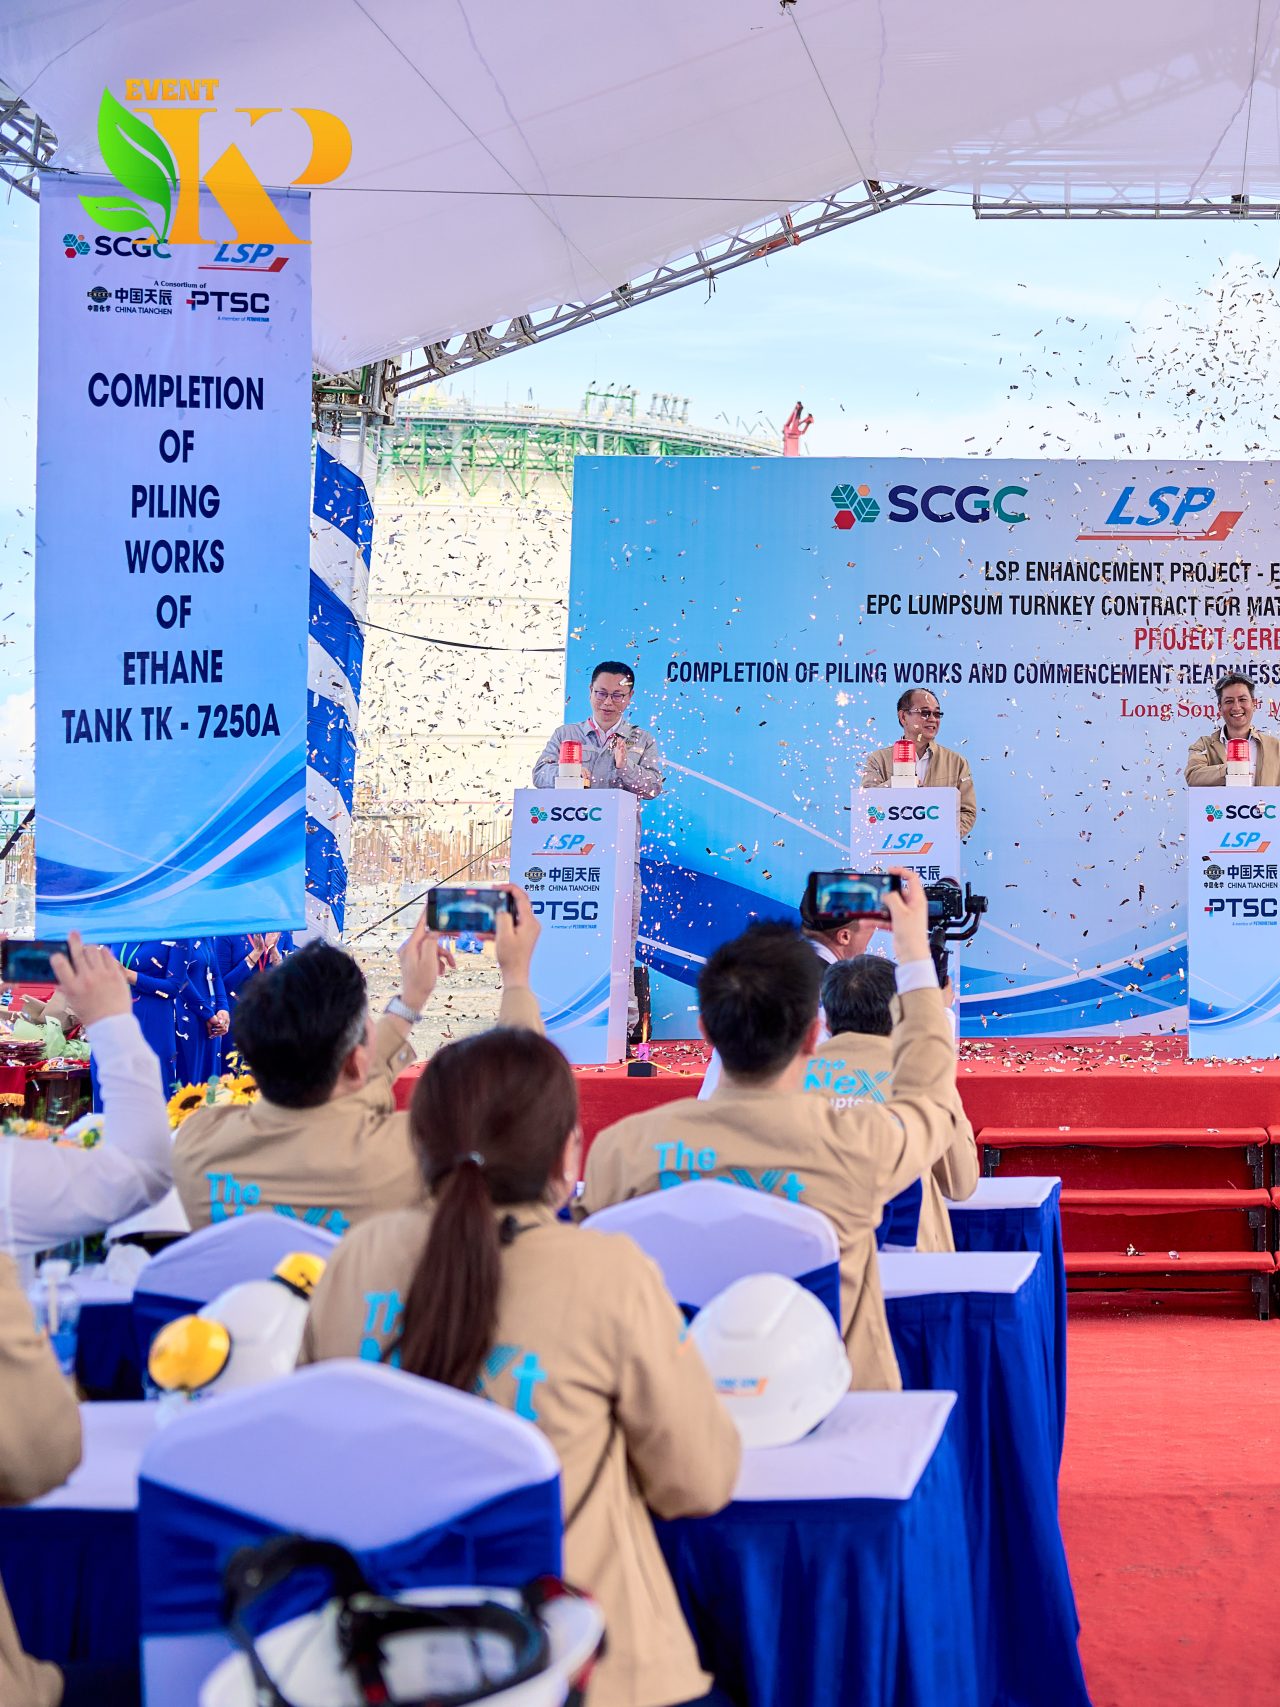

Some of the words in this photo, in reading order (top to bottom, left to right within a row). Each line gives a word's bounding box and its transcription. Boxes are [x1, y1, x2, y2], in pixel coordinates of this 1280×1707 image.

[95, 236, 172, 258] SCGC
[213, 244, 275, 264] LSP
[115, 287, 172, 306] 中国天辰
[186, 291, 270, 313] PTSC
[138, 307, 172, 315] TIANCHEN
[88, 373, 264, 410] COMPLETION
[159, 429, 195, 463] OF
[131, 484, 220, 519] PILING
[888, 485, 1029, 523] SCGC
[1105, 486, 1216, 526] LSP
[125, 539, 225, 574] WORKS
[985, 561, 1019, 581] LSP
[1026, 562, 1163, 582] ENHANCEMENT
[1171, 562, 1252, 582] PROJECT
[156, 594, 192, 629] OF
[867, 595, 901, 615] EPC
[908, 595, 1003, 615] LUMPSUM
[1010, 596, 1095, 616] TURNKEY
[1102, 596, 1198, 616] CONTRACT
[1205, 596, 1240, 616] FOR
[1135, 628, 1225, 650] PROJECT
[123, 649, 223, 686] ETHANE
[667, 662, 788, 683] COMPLETION
[795, 662, 819, 683] OF
[826, 663, 887, 683] PILING
[894, 663, 962, 683] WORKS
[968, 664, 1007, 684] AND
[1013, 664, 1173, 684] COMMENCEMENT
[1120, 698, 1172, 721] Long
[62, 708, 132, 744] TANK
[141, 706, 172, 741] TK
[197, 703, 280, 740] 7250A
[551, 807, 602, 821] SCGC
[888, 806, 939, 820] SCGC
[1226, 805, 1276, 819] SCGC
[882, 833, 923, 849] LSP
[1220, 832, 1261, 848] LSP
[549, 867, 600, 882] 中国天辰
[1227, 864, 1278, 879] 中国天辰
[1204, 898, 1277, 917] PTSC
[804, 1069, 891, 1104] NeX
[653, 1140, 717, 1171] The
[205, 1172, 261, 1206] The
[364, 1290, 405, 1334] Th
